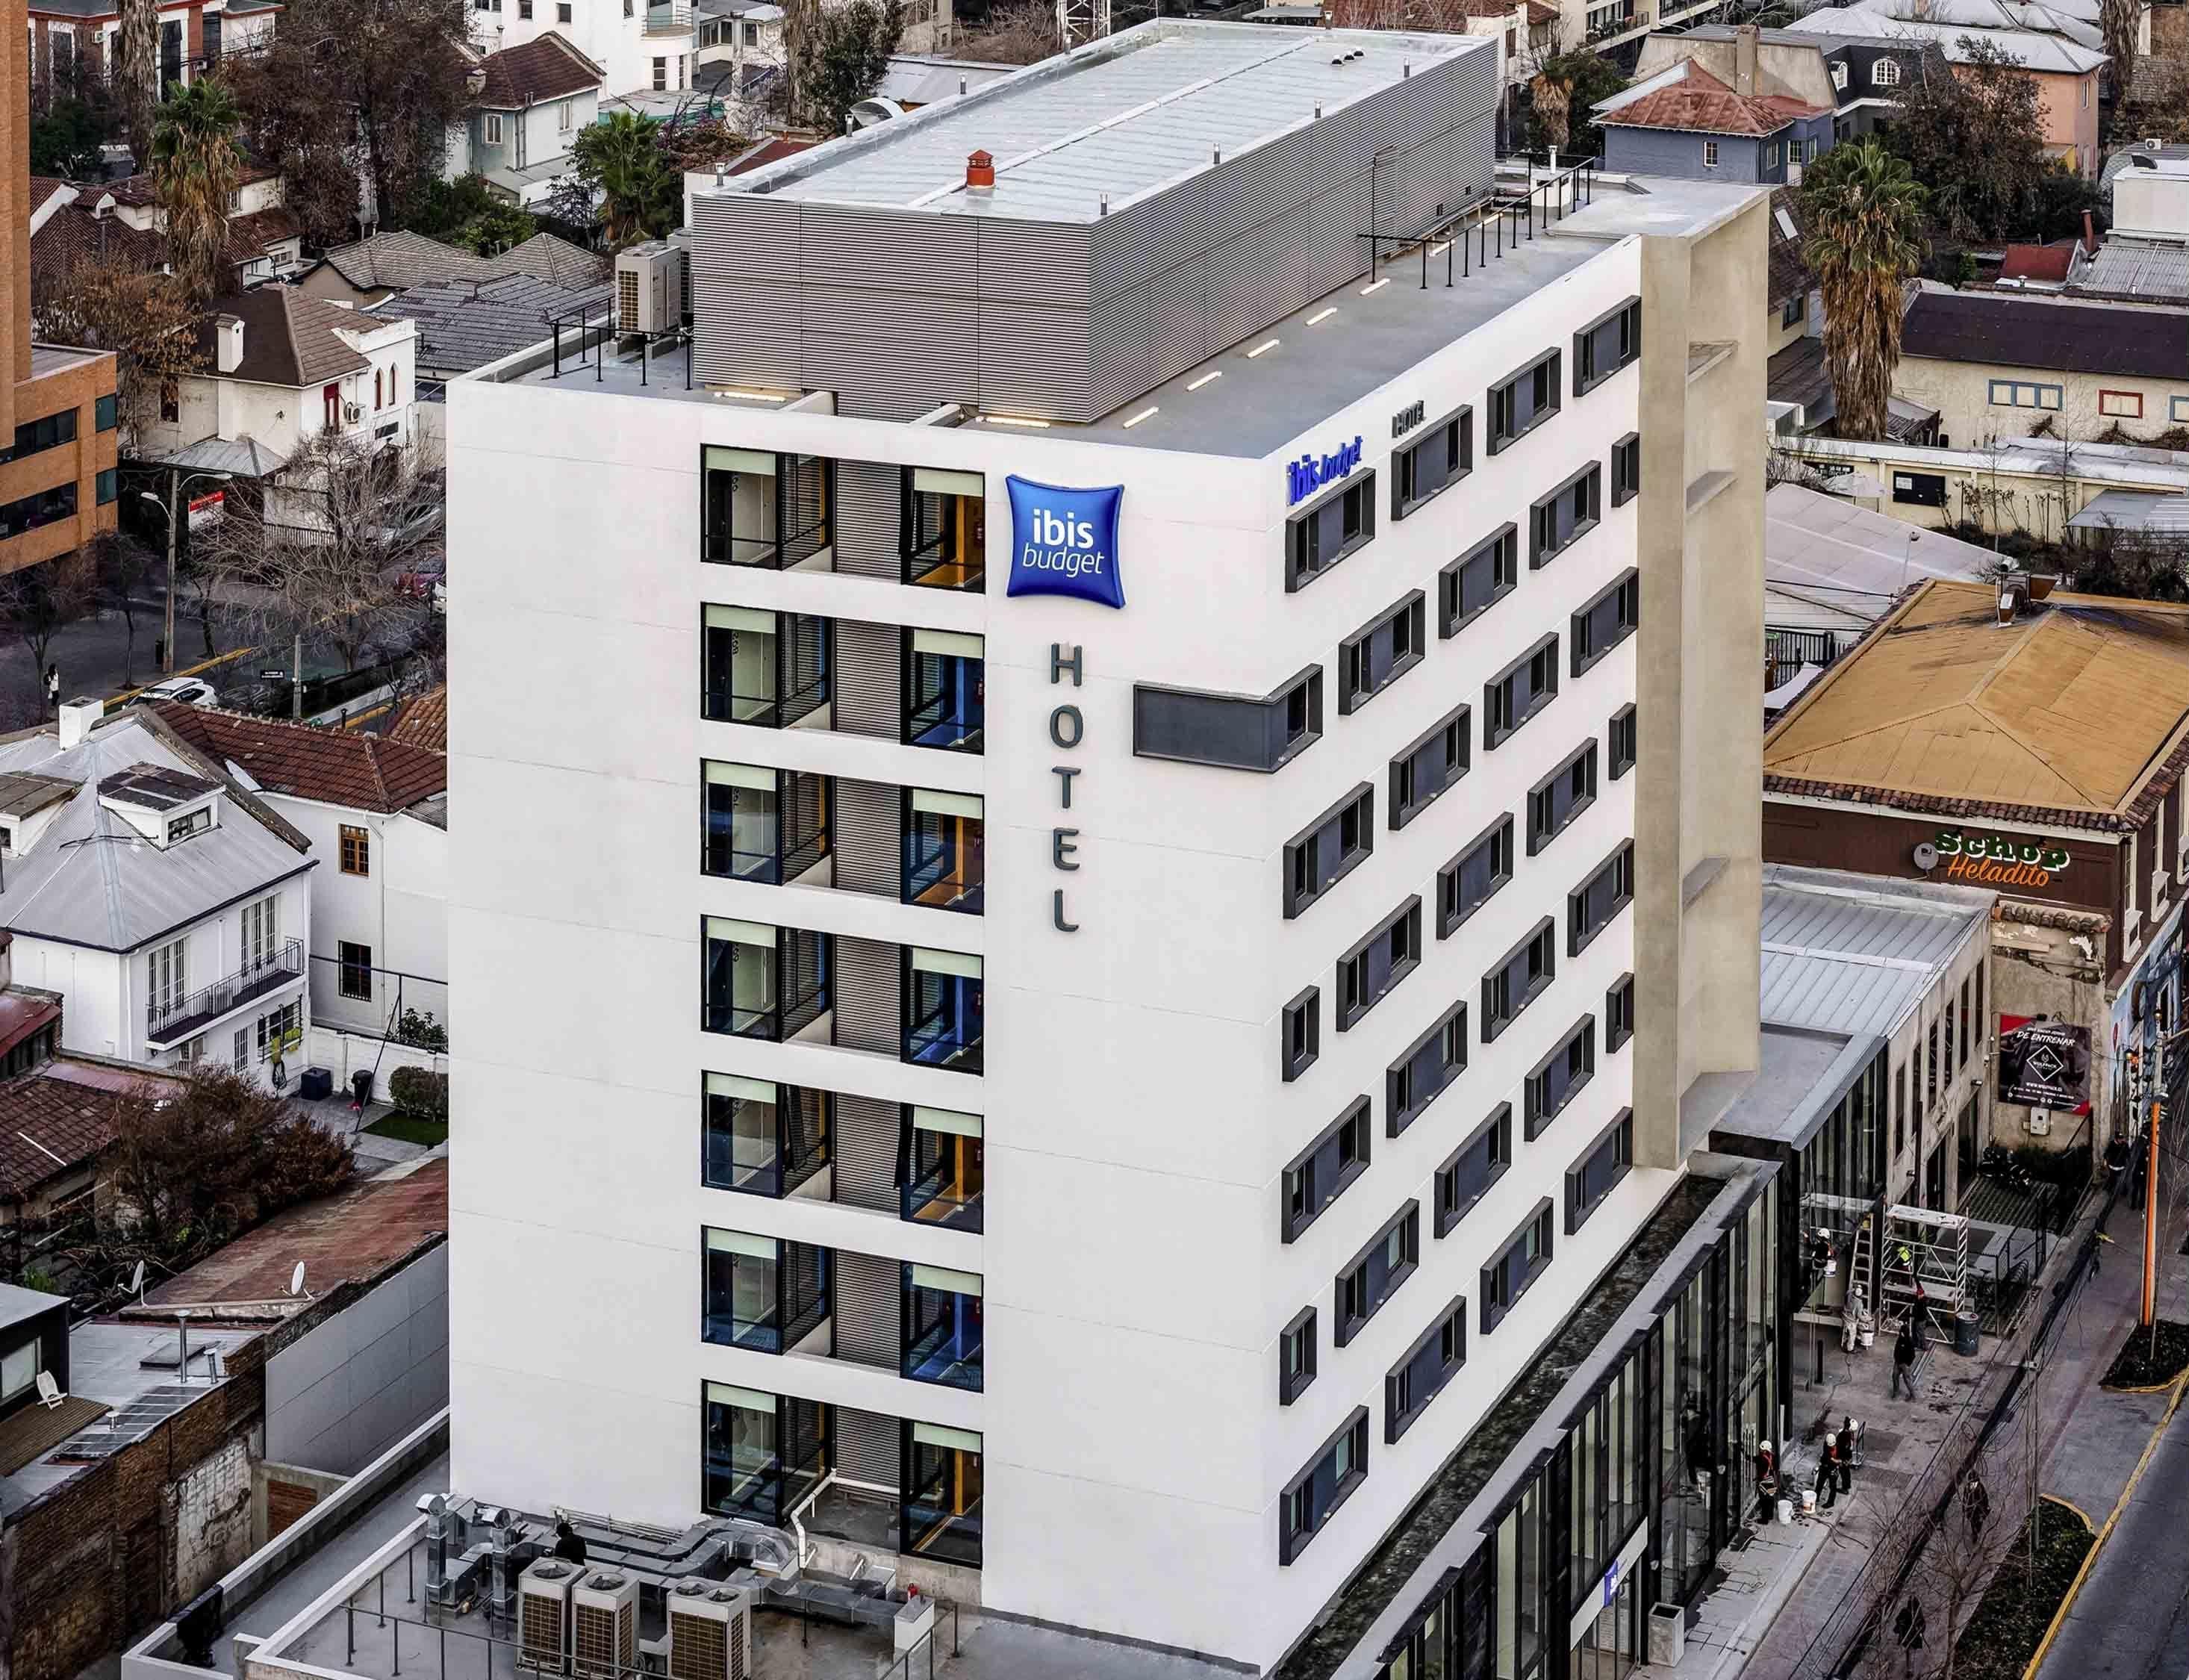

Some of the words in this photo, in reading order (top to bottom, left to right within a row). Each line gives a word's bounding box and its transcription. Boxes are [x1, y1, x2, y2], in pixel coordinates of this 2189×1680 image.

[1392, 400, 1426, 438] HOTEL
[1286, 453, 1320, 506] ibis
[1319, 435, 1364, 484] budget
[1033, 508, 1094, 550] ibis
[1022, 542, 1105, 578] budget
[1049, 642, 1083, 933] HOTEL
[1946, 854, 2049, 887] Heladito
[2016, 1031, 2030, 1039] DE
[2030, 1033, 2076, 1046] ENTRENAR
